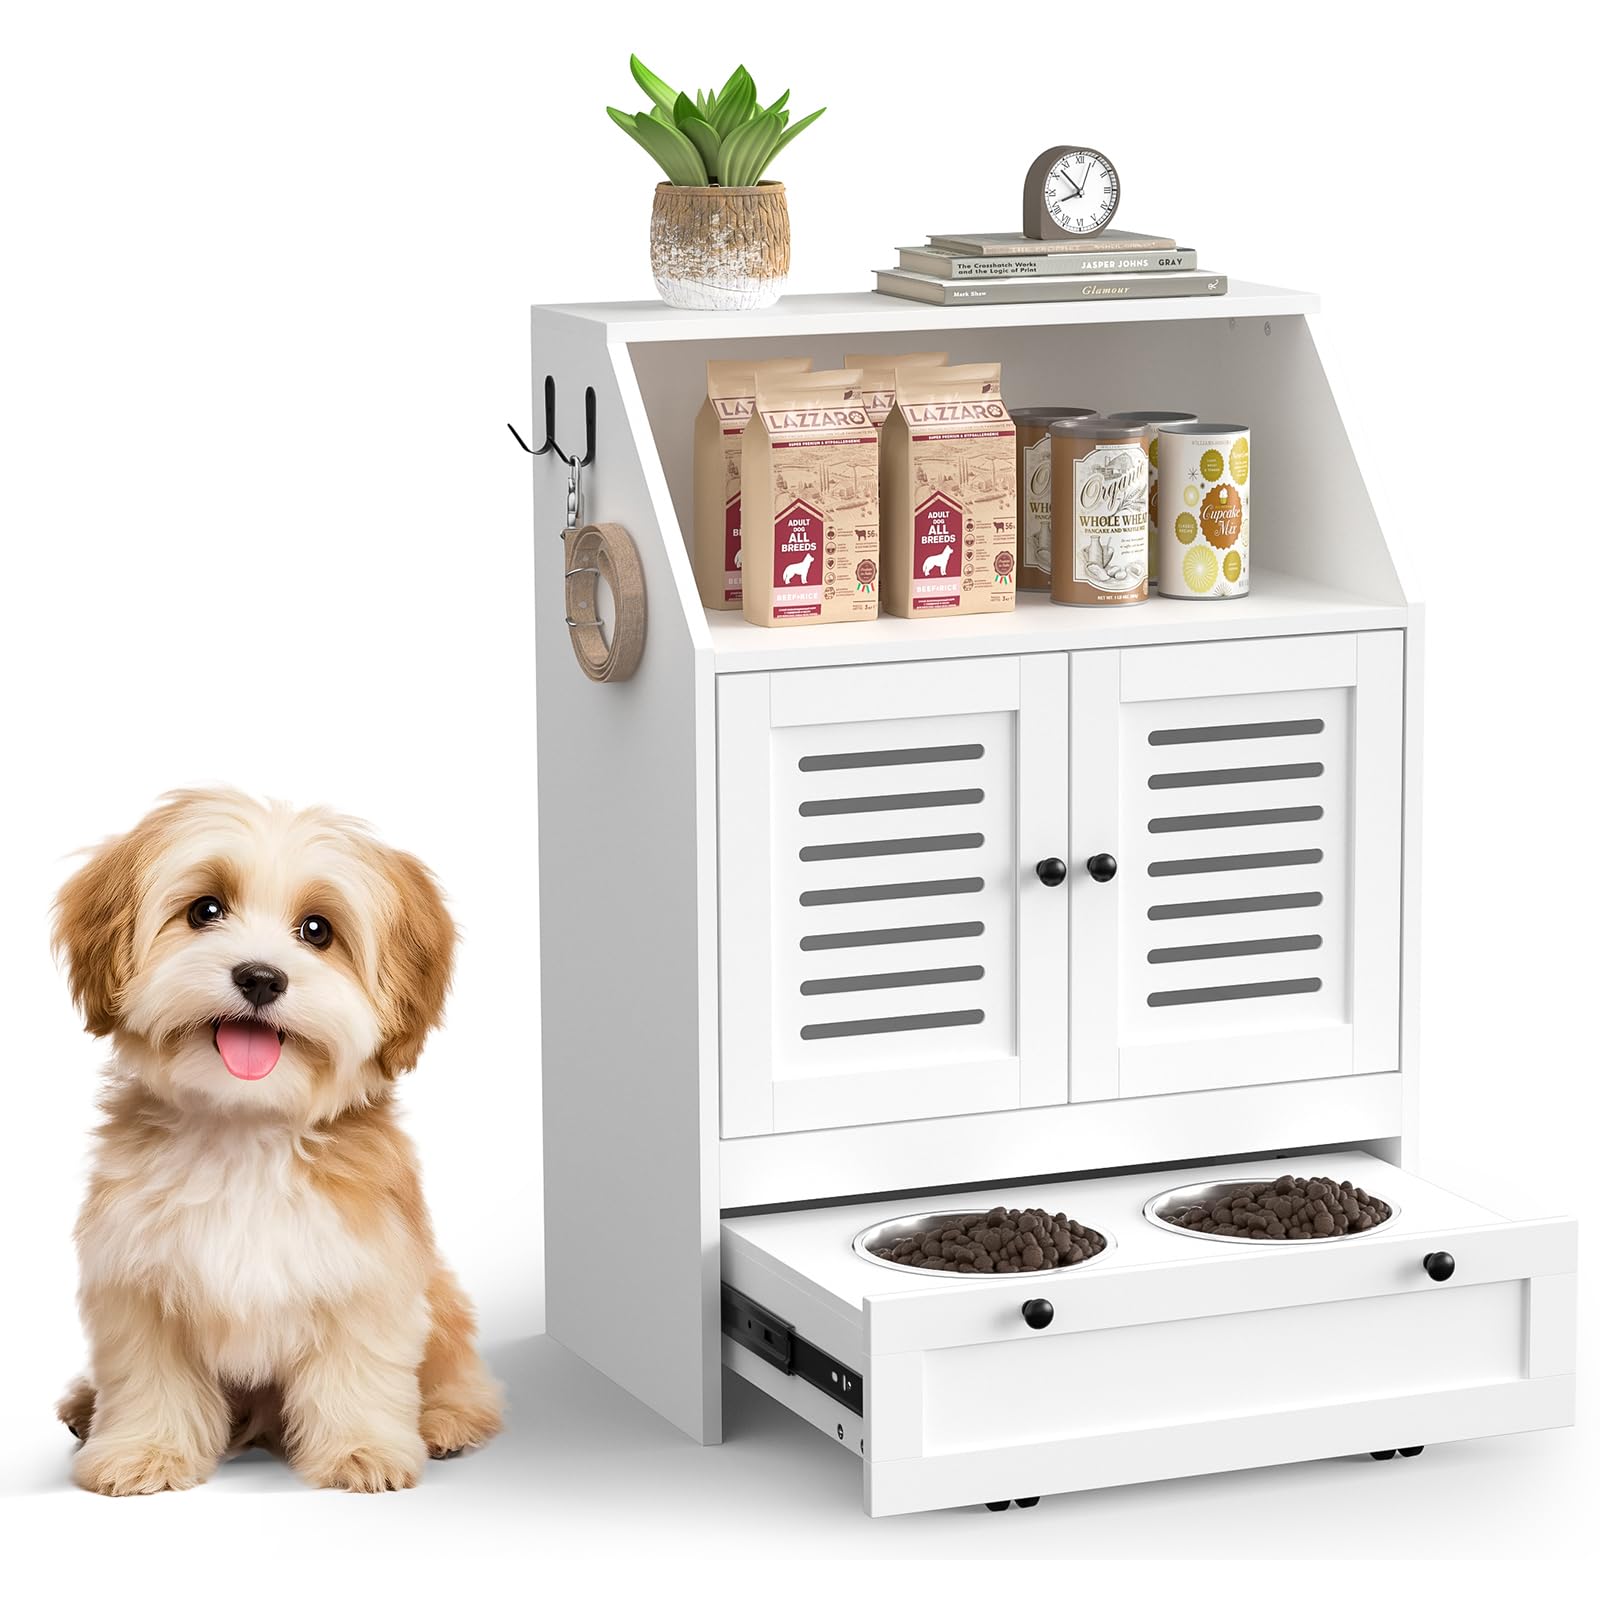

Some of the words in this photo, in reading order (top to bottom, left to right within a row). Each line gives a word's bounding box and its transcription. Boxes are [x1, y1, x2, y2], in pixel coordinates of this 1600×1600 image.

[1118, 260, 1148, 268] JOHNS
[1082, 285, 1130, 295] Glamour
[909, 404, 1003, 422] LAZZARO
[770, 410, 865, 429] LAZZARO
[1080, 460, 1144, 517] Organic
[1202, 504, 1240, 523] Cupcake
[1080, 515, 1120, 526] WHOLE
[928, 525, 948, 534] ALL
[1214, 520, 1237, 536] Mix
[789, 532, 809, 543] ALL
[922, 535, 955, 544] BREEDS
[782, 543, 816, 552] BREEDS
